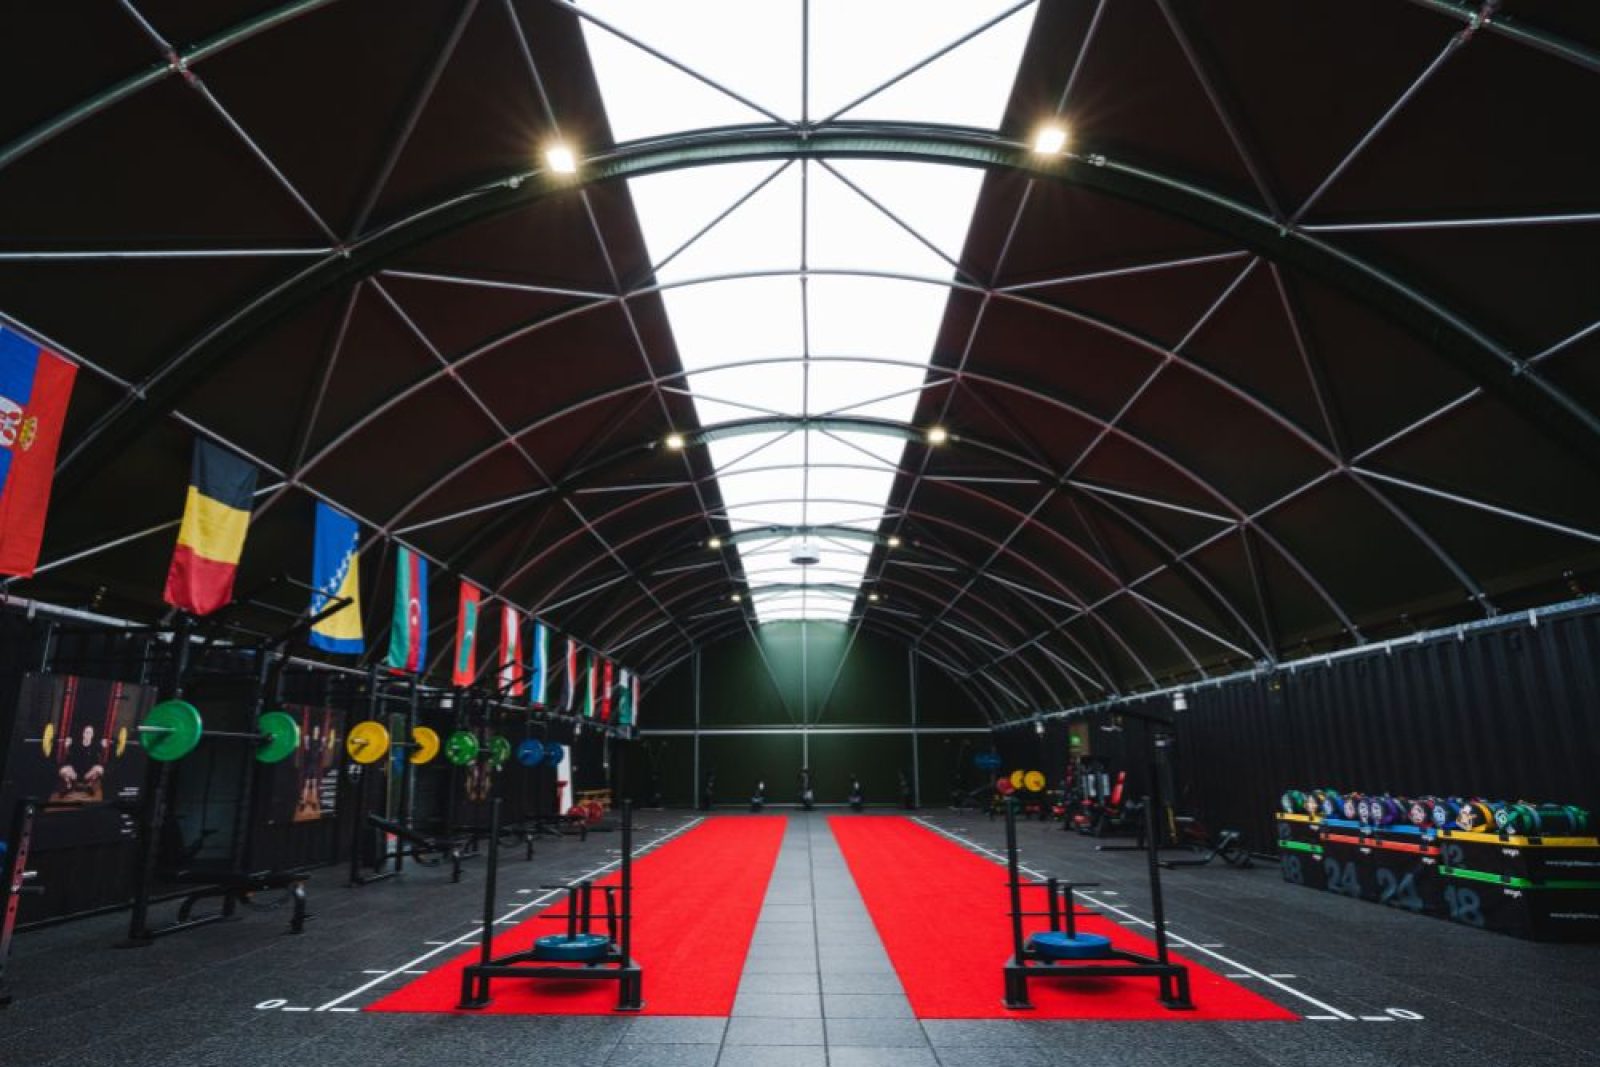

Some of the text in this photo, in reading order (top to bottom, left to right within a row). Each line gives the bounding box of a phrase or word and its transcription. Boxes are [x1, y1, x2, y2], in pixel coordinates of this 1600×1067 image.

[1324, 857, 1361, 897] 24
[1376, 868, 1424, 910] 24
[1443, 883, 1485, 927] 18
